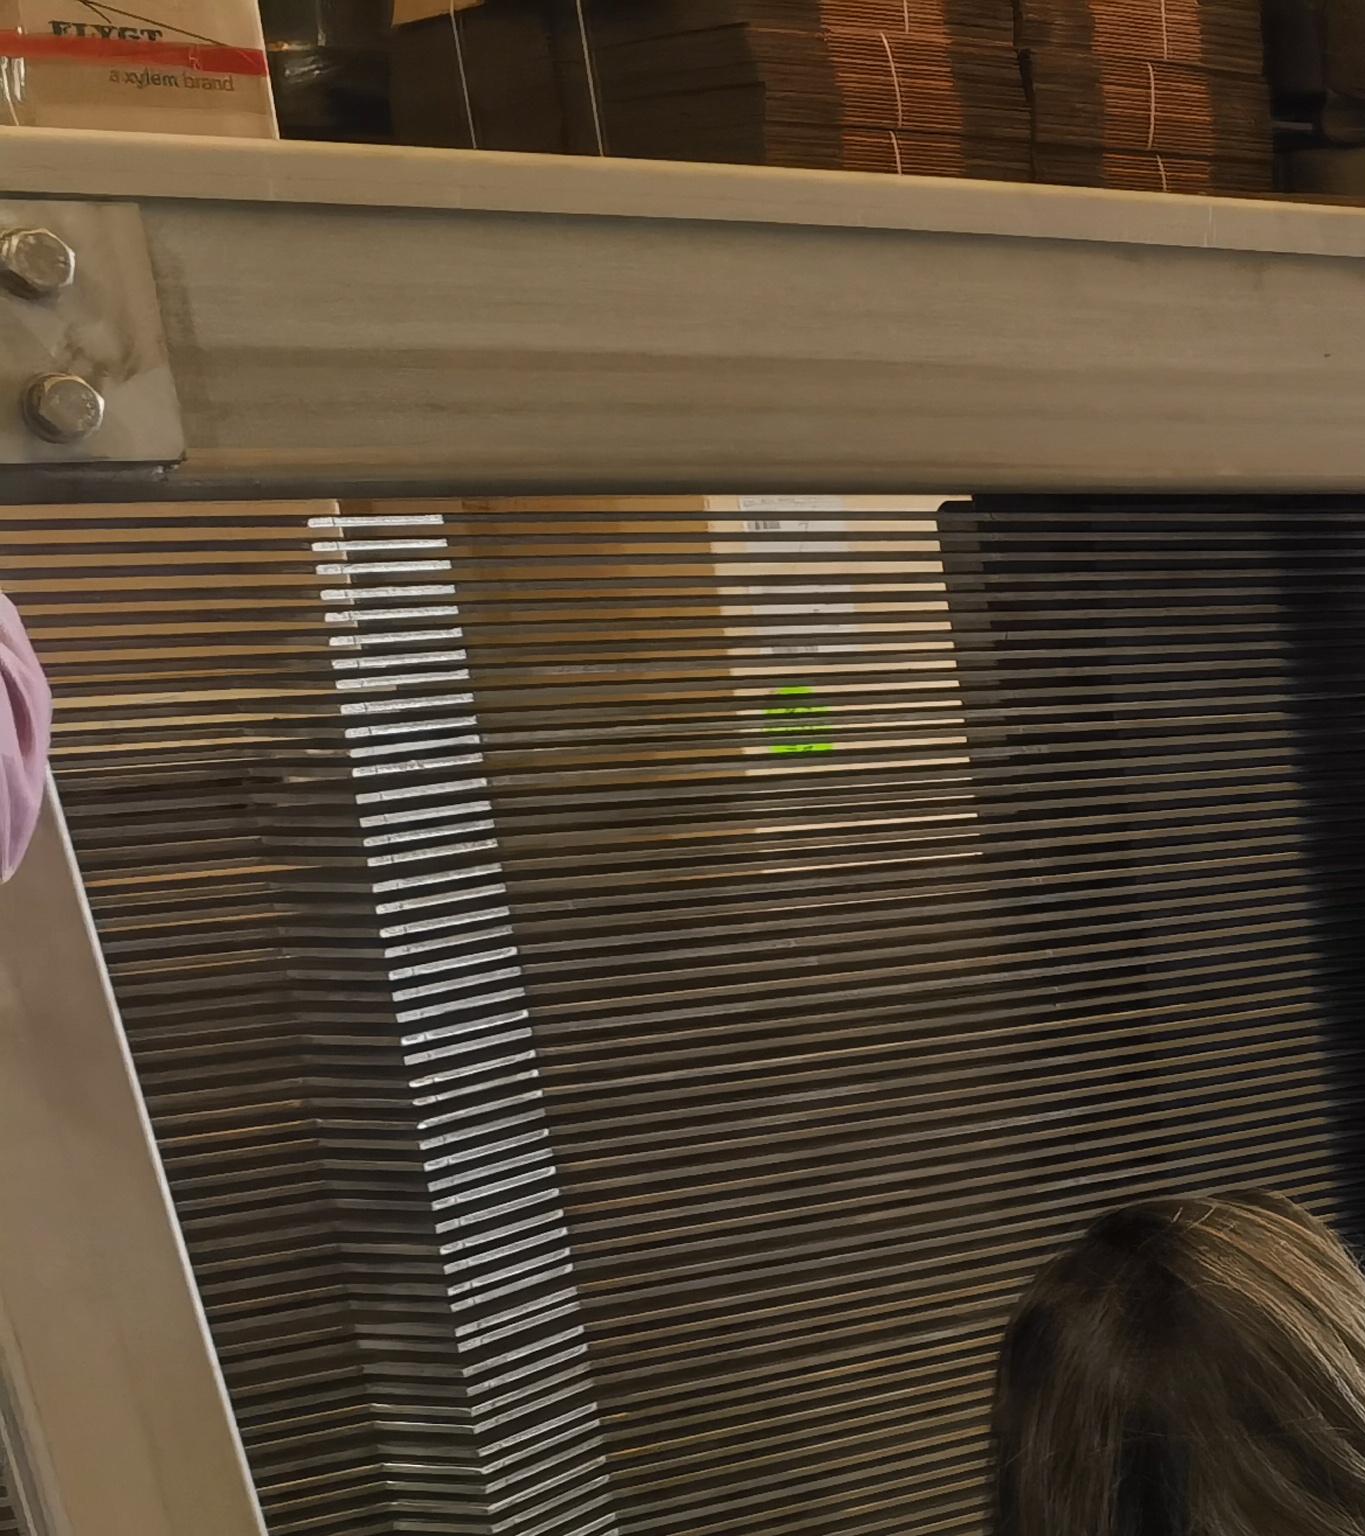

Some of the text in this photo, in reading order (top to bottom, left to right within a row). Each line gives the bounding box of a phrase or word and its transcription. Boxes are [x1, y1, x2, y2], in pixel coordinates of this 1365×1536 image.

[109, 67, 235, 92] a xylem brand
